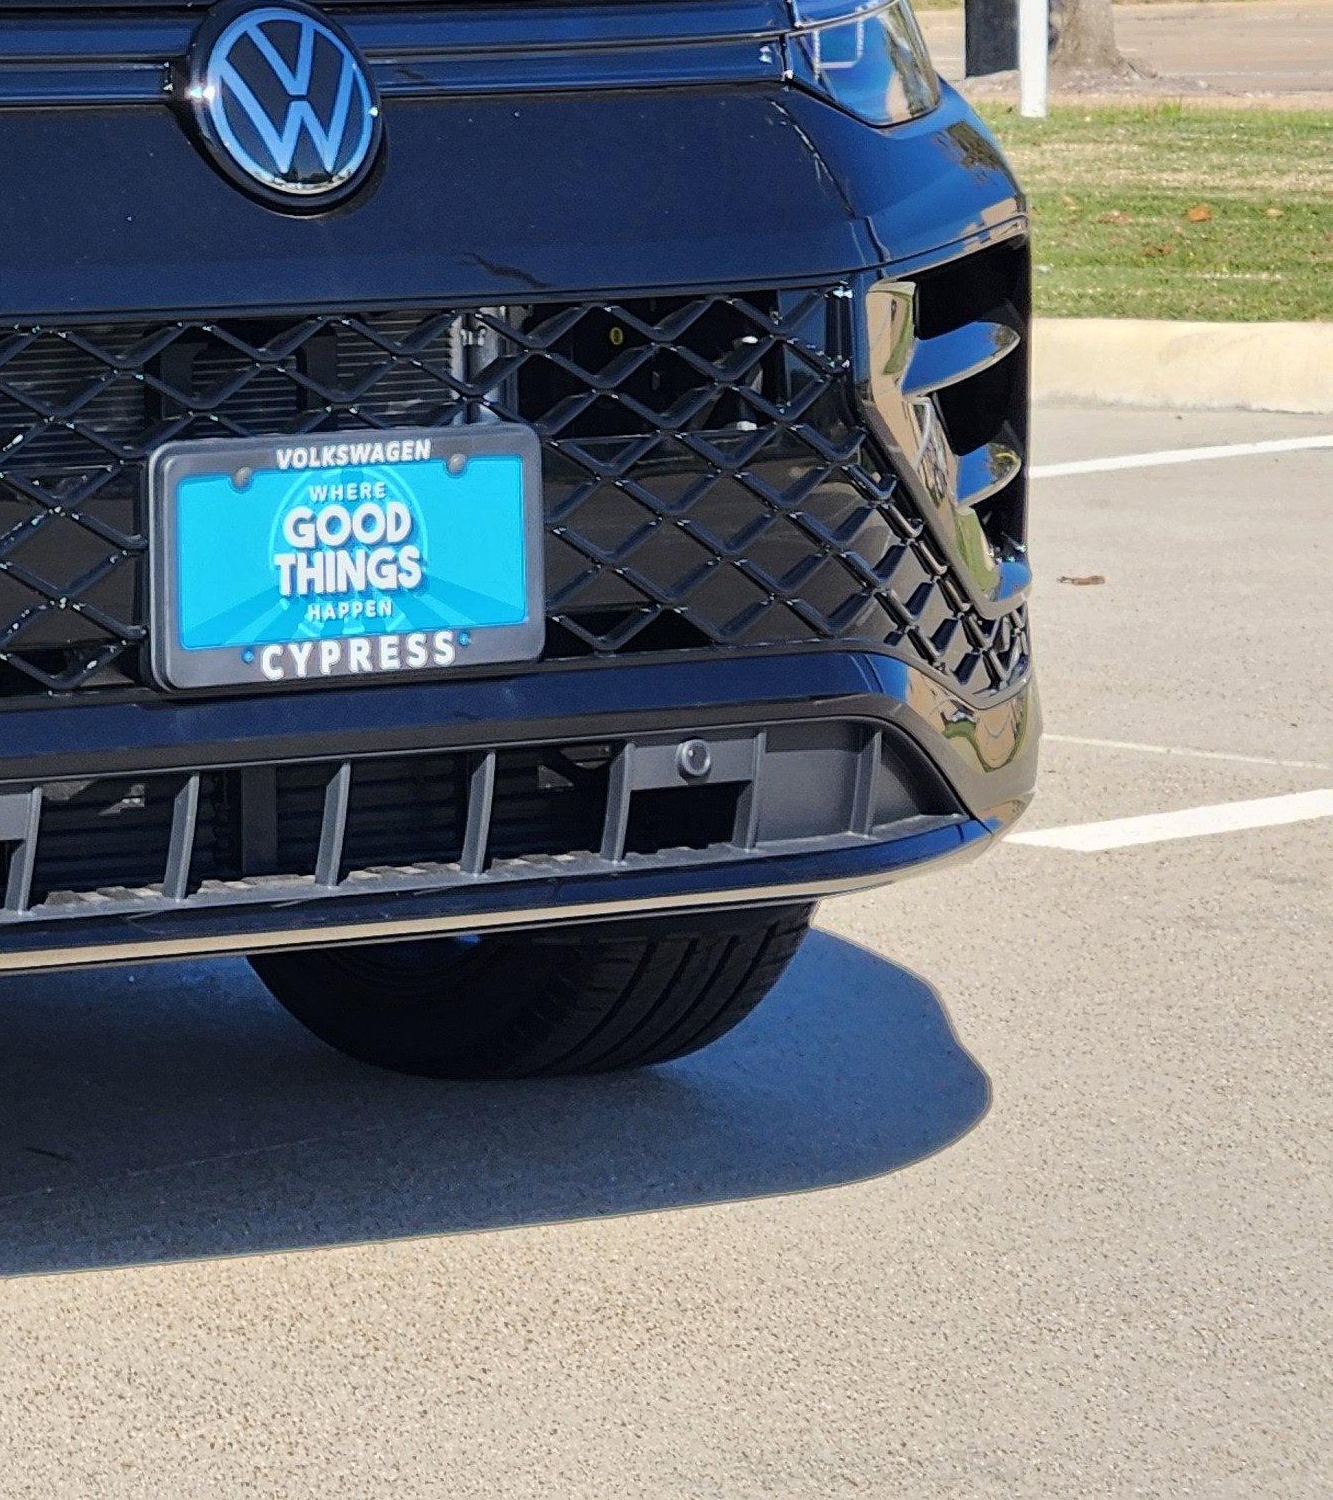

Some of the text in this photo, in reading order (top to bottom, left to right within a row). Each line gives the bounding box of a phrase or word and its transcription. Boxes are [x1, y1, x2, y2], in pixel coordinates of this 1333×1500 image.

[276, 439, 432, 470] VOLKSWAGEN
[309, 481, 387, 502] WHERE
[283, 501, 413, 549] GOOD
[274, 545, 423, 596] THINGS
[307, 600, 393, 621] HAPPEN
[260, 631, 455, 680] CYPRESS
